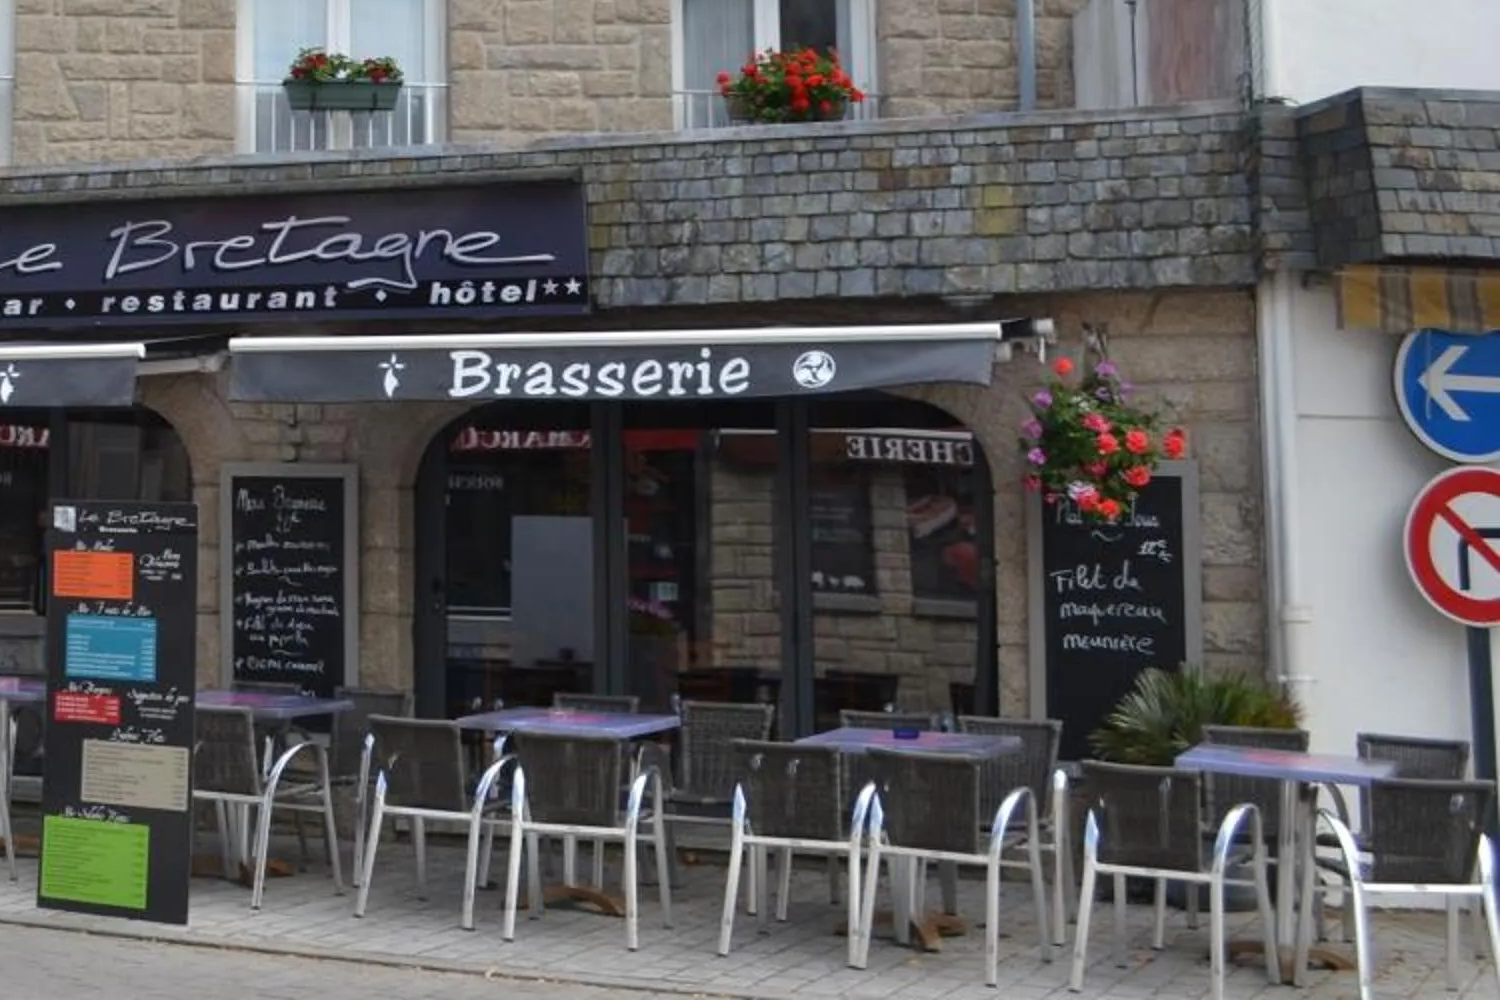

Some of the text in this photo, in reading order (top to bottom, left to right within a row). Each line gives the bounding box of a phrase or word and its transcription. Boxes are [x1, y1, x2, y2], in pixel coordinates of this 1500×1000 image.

[106, 216, 553, 289] Bretagne
[101, 286, 337, 314] restaurant
[430, 280, 537, 306] hôtel
[449, 348, 751, 396] Brasserie
